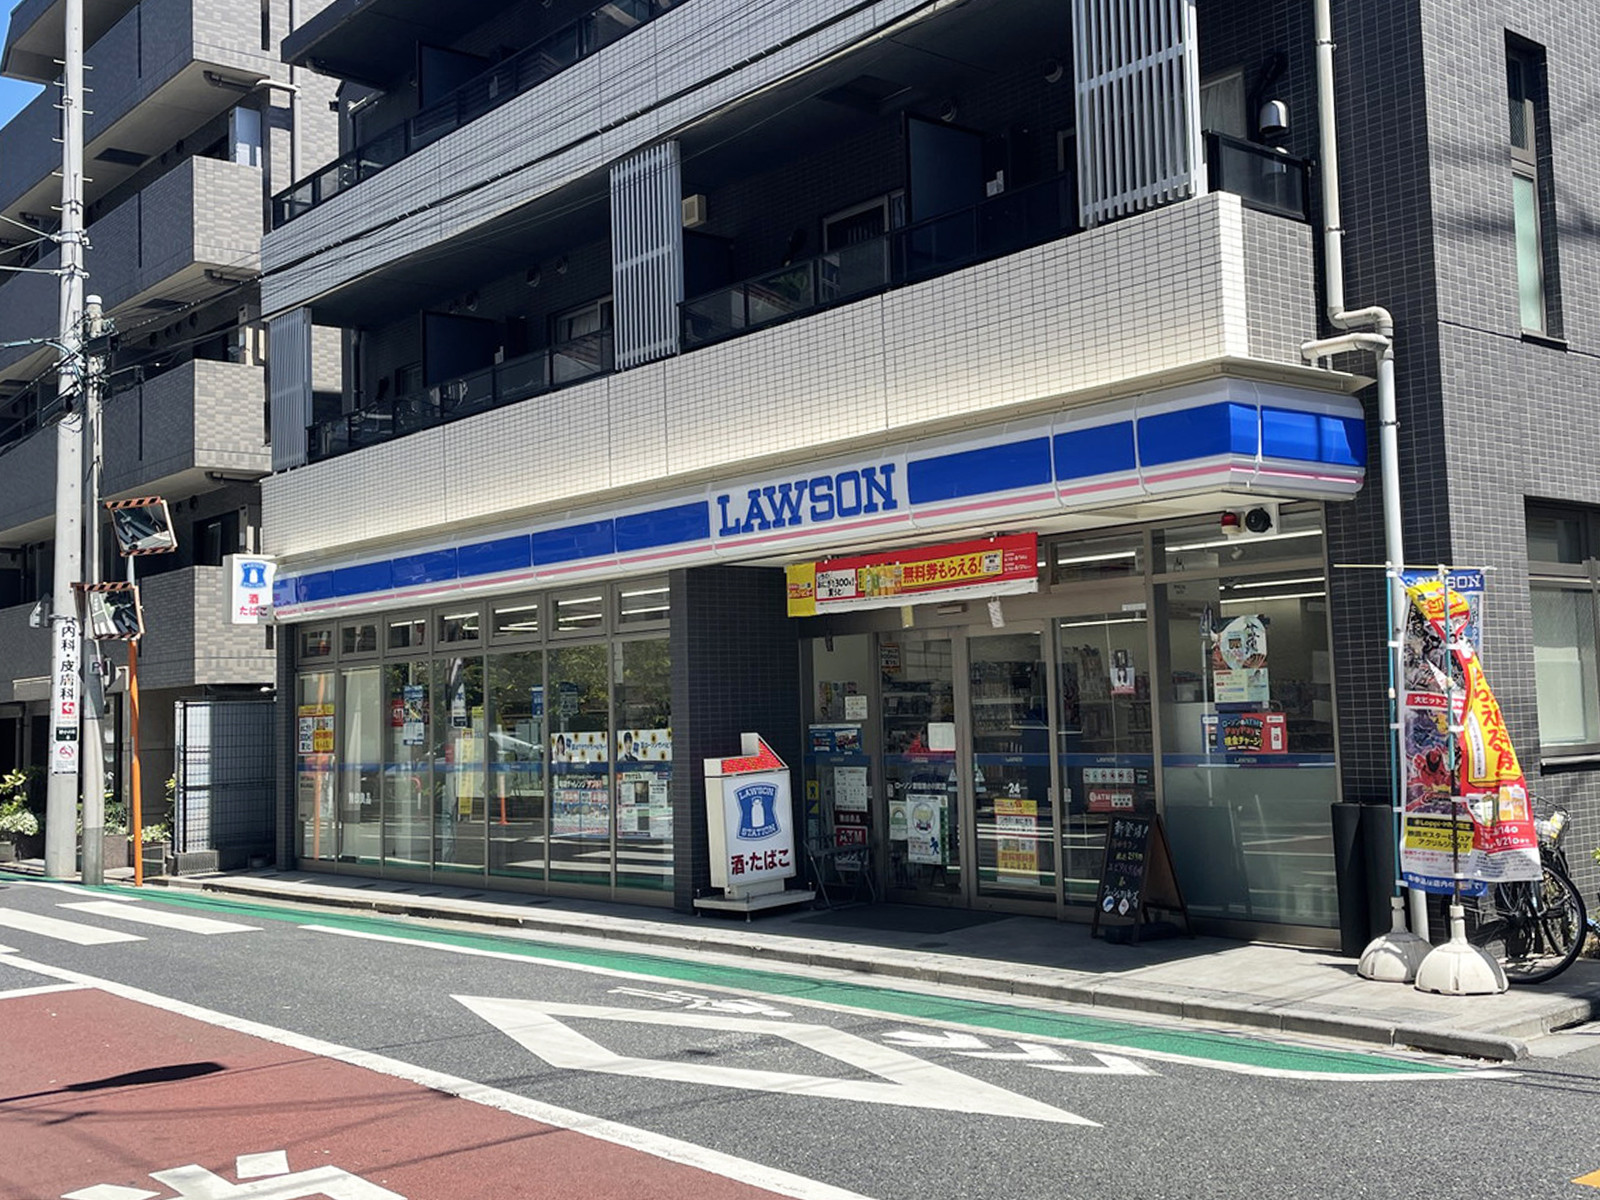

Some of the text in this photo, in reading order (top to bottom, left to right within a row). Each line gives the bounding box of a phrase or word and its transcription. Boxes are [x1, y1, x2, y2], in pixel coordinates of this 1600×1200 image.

[717, 463, 898, 537] LAWSON
[902, 555, 983, 584] 無料券もらえる!
[249, 594, 259, 604] 酒
[240, 605, 268, 617] たばこ
[60, 625, 76, 700] 内科・皮膚科
[739, 786, 775, 801] LAWSON
[1008, 782, 1020, 794] 24
[741, 823, 776, 837] STATION
[839, 830, 862, 843] ATM
[731, 849, 791, 875] 酒・たばこ
